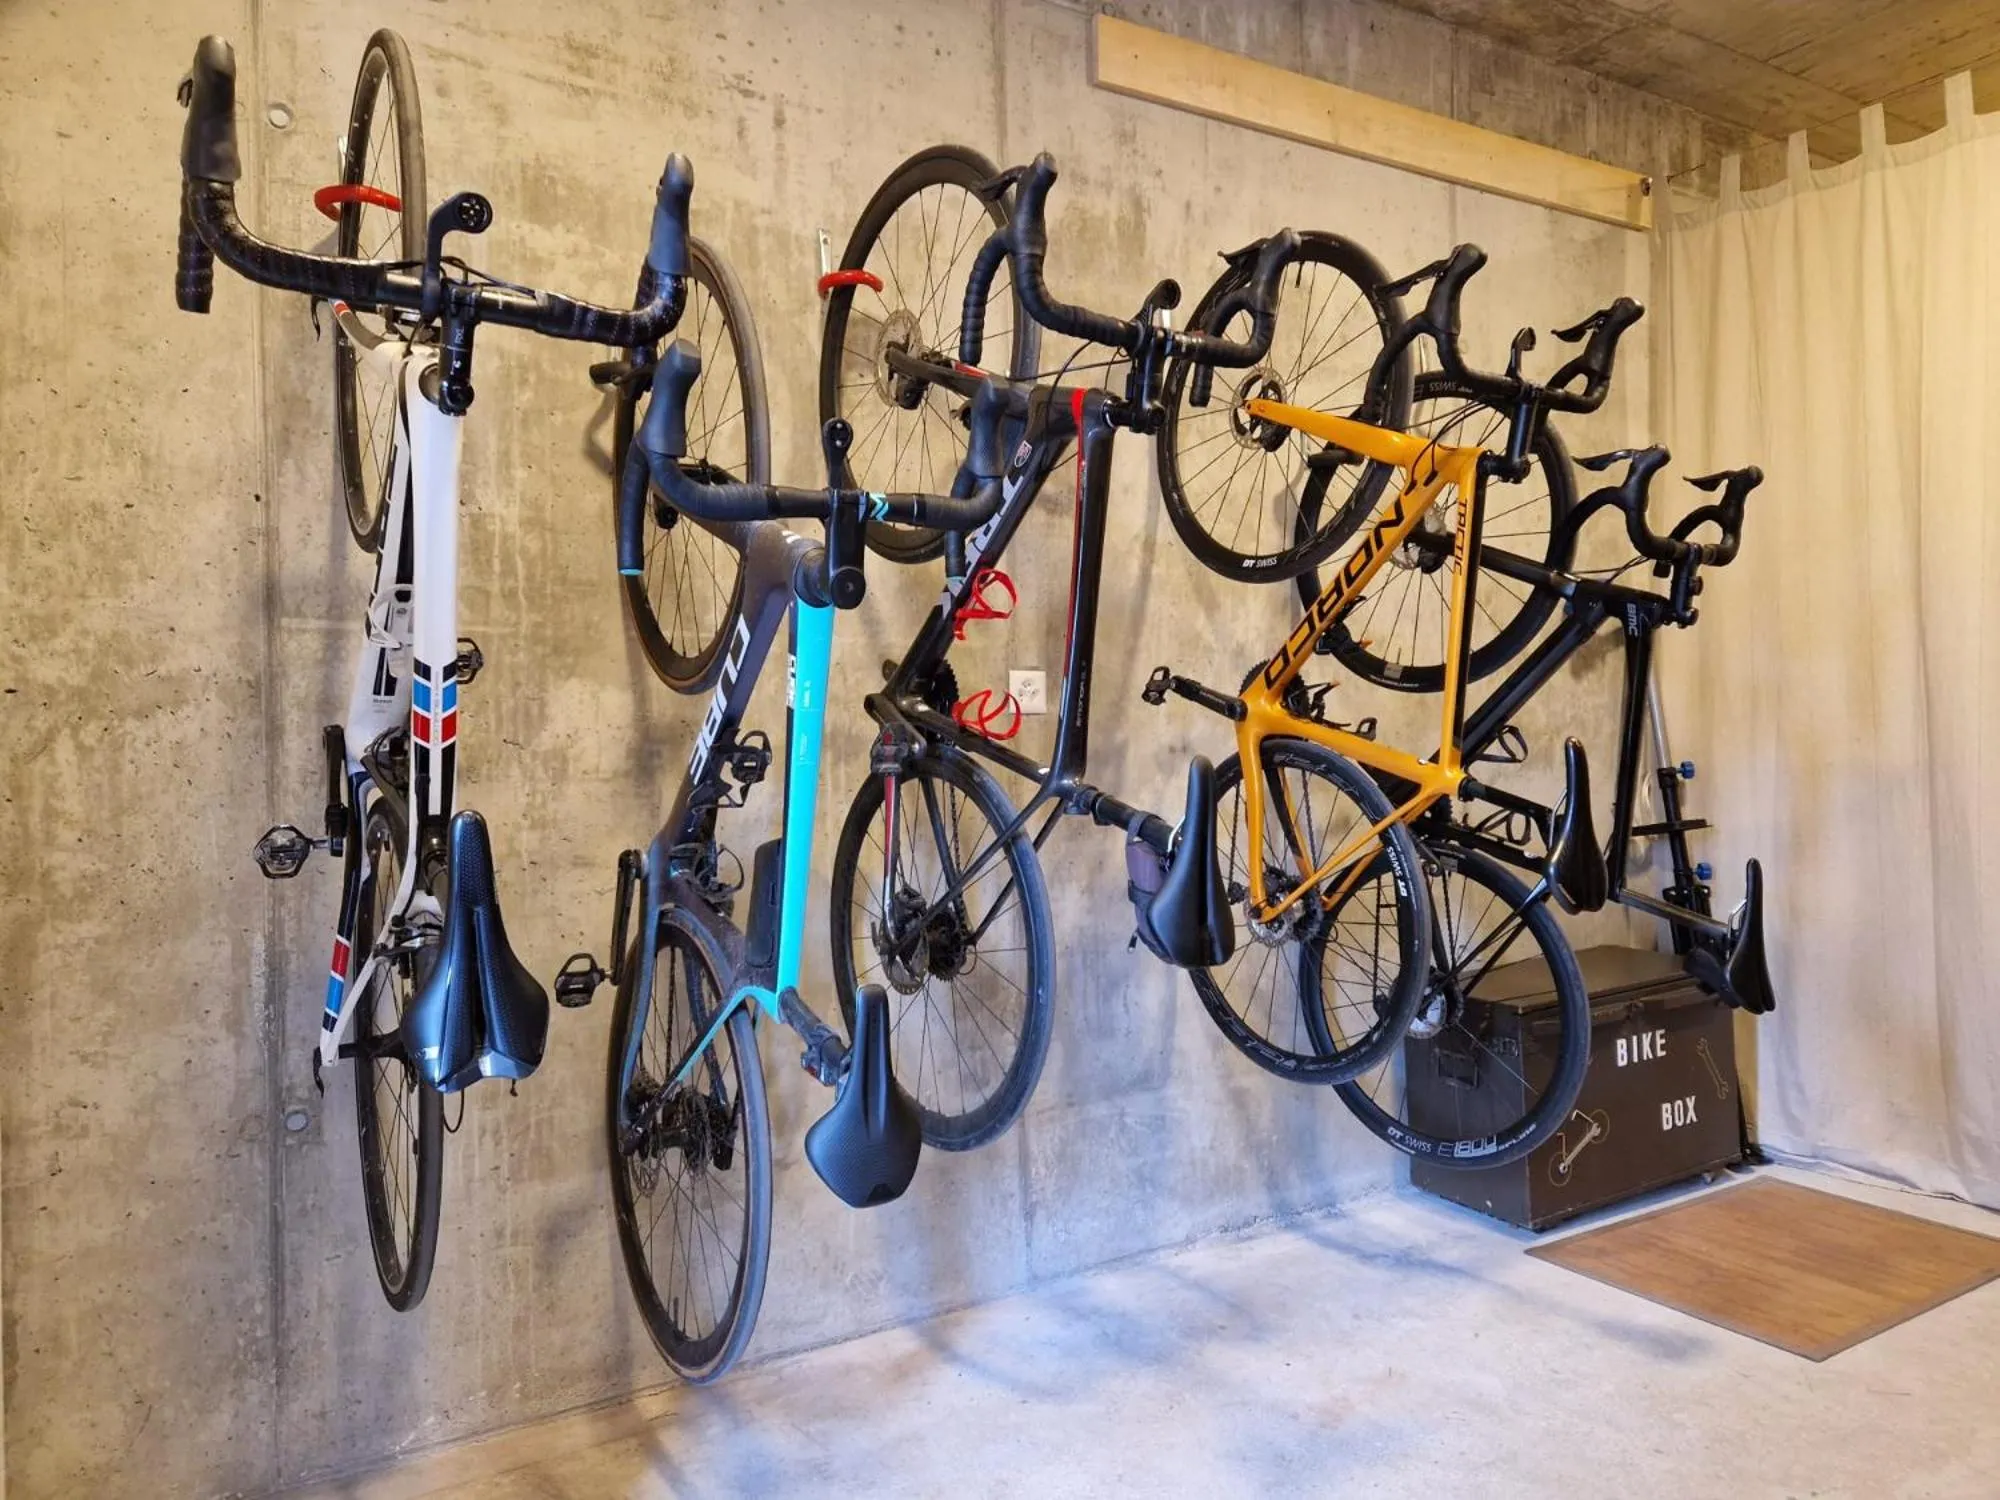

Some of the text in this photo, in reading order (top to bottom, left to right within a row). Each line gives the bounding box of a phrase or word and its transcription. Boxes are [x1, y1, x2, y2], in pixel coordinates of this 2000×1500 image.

[1242, 559, 1256, 568] DT
[1264, 500, 1405, 690] NORCO
[689, 613, 751, 787] CUBE
[1386, 846, 1403, 877] SWISS
[1397, 879, 1408, 897] DT
[1617, 1029, 1667, 1067] BIKE
[1662, 1095, 1698, 1131] BOX
[1387, 1126, 1404, 1140] DT
[1405, 1135, 1432, 1153] SWISS
